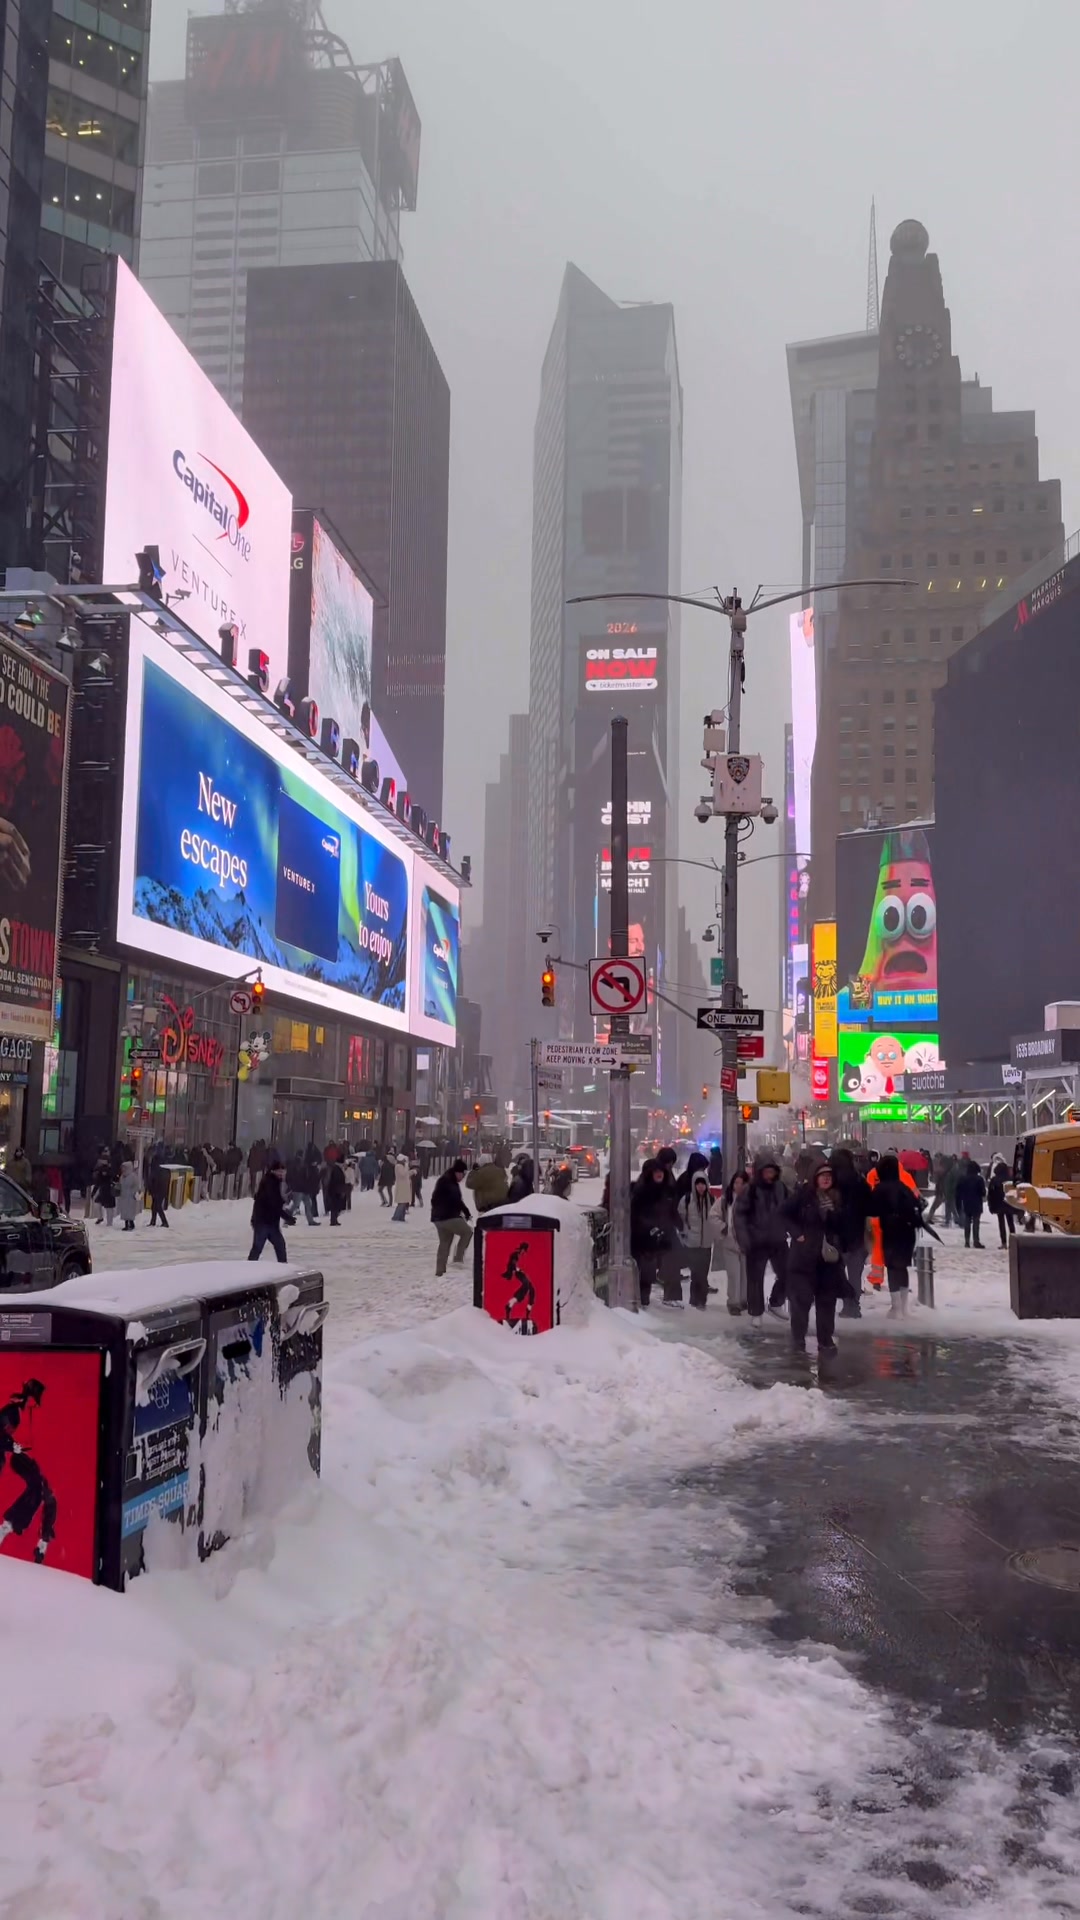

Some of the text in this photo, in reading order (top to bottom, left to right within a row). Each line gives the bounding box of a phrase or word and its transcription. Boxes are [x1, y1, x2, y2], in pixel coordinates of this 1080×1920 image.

[172, 549, 247, 640] VENTURE X
[1031, 569, 1065, 602] MARRIOTT
[1031, 585, 1061, 614] MARQUIS
[607, 622, 638, 634] 2026
[586, 647, 657, 660] ON SALE
[2, 653, 50, 701] SEE HOW THE
[585, 659, 658, 680] NOW
[7, 683, 45, 728] COULD
[47, 707, 62, 738] BE
[197, 771, 237, 829] New
[601, 801, 651, 813] JHN
[601, 813, 651, 825] CIST
[180, 828, 248, 888] escapes
[602, 846, 651, 861] LVE
[282, 865, 316, 894] VENTURE X
[601, 877, 649, 888] MCH 1
[364, 881, 390, 923] Yours
[358, 921, 392, 966] to enjoy
[17, 972, 52, 990] SENSATION
[707, 1014, 756, 1025] ONE WAY
[546, 1044, 583, 1054] PEDESTRIAN
[584, 1046, 601, 1055] FLOW
[602, 1046, 618, 1056] ZONE
[1015, 1038, 1056, 1058] 1535 BROADWAY
[546, 1055, 586, 1065] KEEP MOVING
[911, 1074, 940, 1090] swatch
[124, 1497, 154, 1529] TIMES
